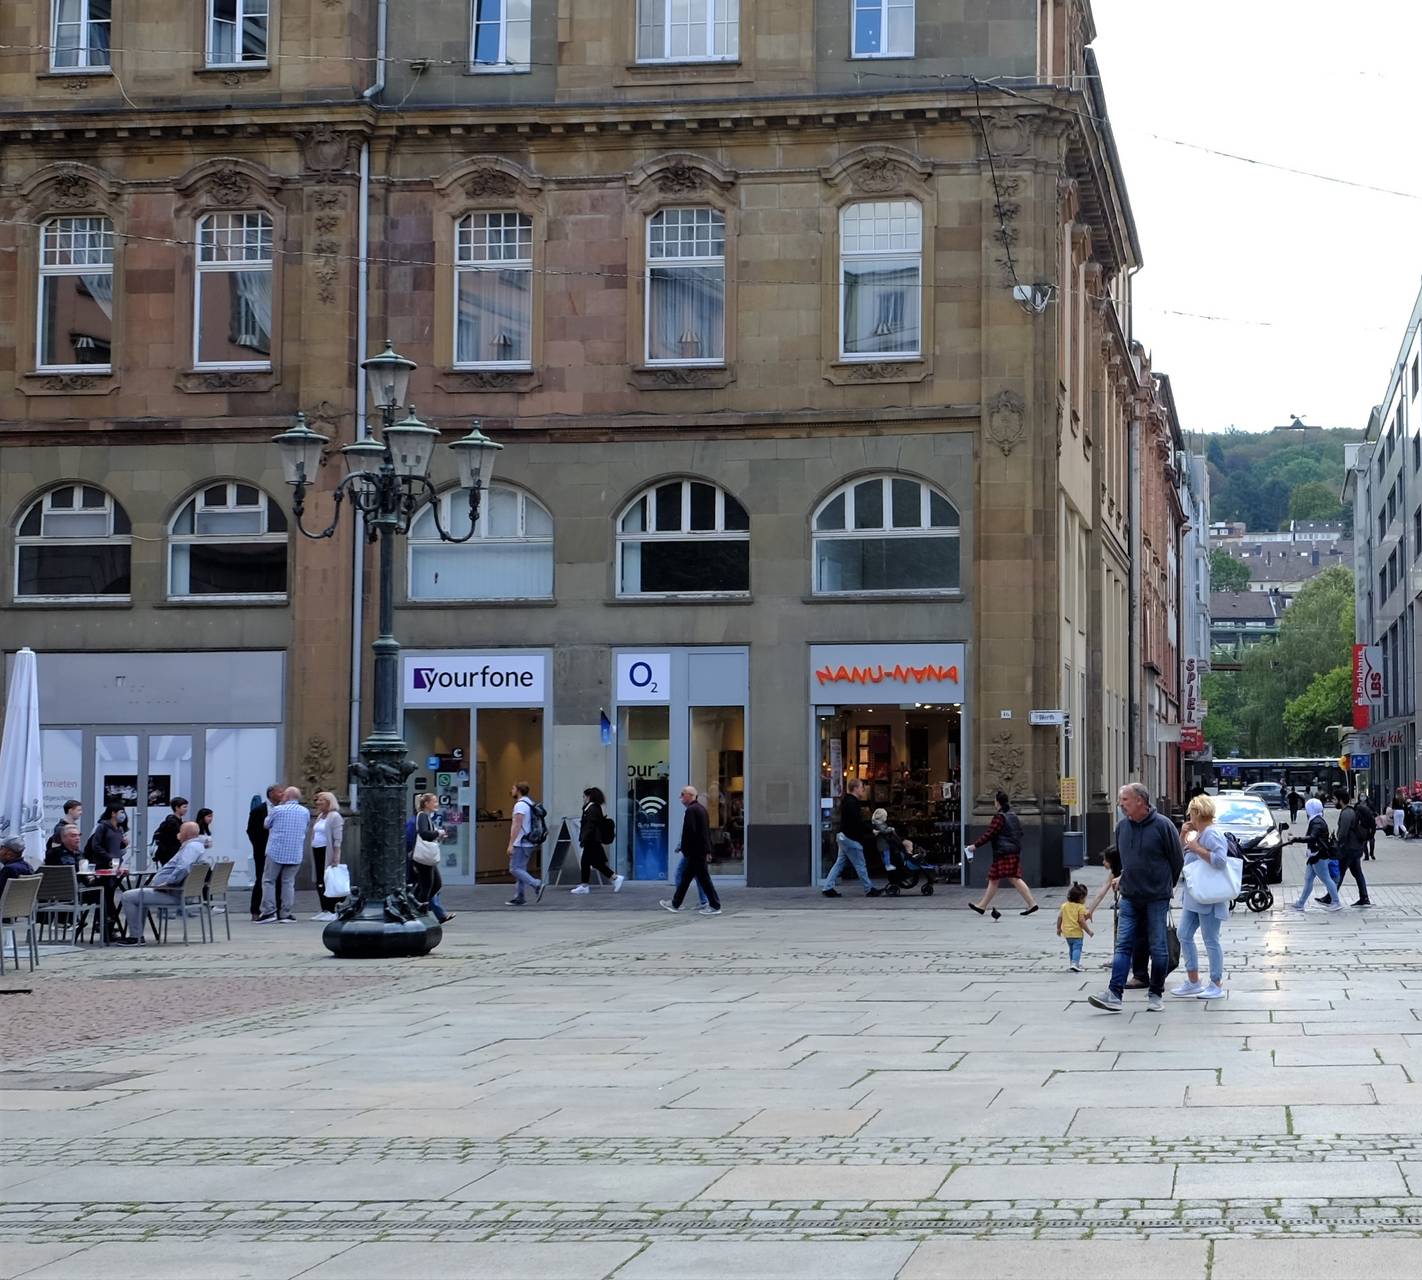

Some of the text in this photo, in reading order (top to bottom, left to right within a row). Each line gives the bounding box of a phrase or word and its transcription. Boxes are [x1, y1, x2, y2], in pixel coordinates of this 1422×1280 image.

[420, 665, 534, 693] yourfone
[815, 664, 959, 687] NANU-NANA
[1370, 672, 1382, 699] LBS
[1185, 657, 1197, 724] SPIEL
[43, 779, 78, 789] rmieten
